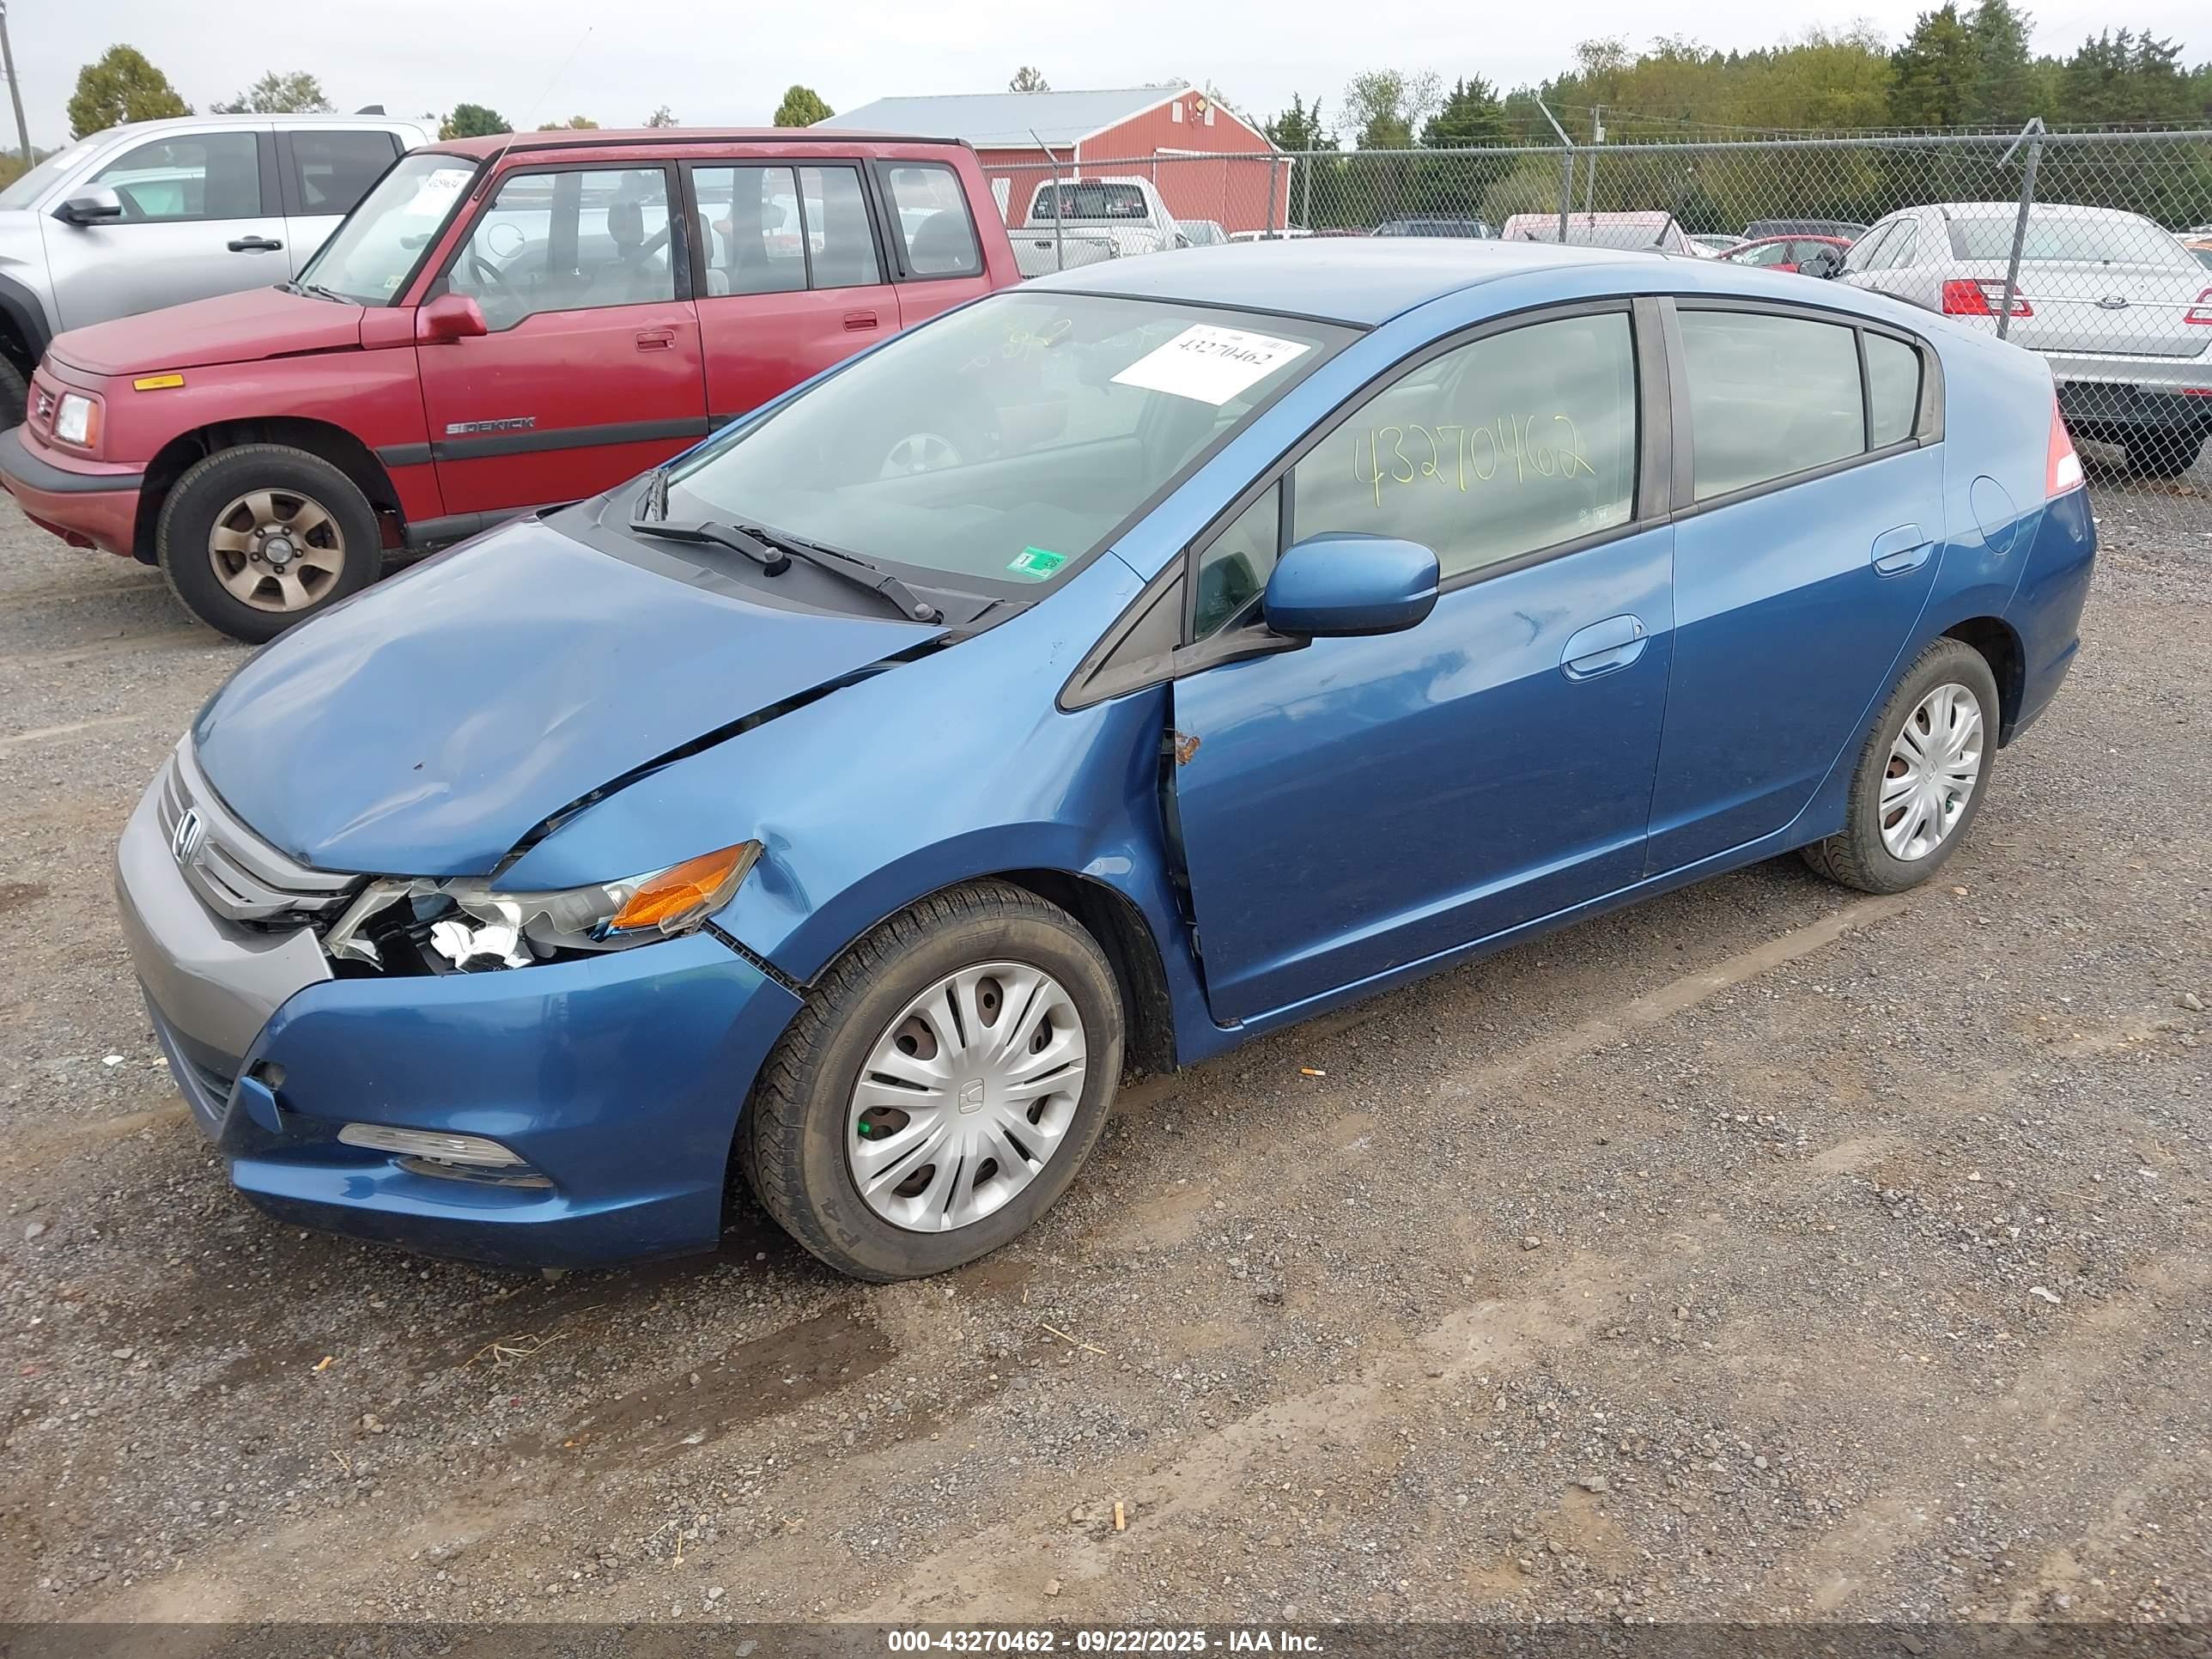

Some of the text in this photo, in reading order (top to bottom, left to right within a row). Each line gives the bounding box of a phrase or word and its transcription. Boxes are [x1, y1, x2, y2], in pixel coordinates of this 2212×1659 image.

[1179, 339, 1273, 365] 43270462
[446, 416, 536, 434] SIDEKICK
[1354, 413, 1595, 507] 43270462
